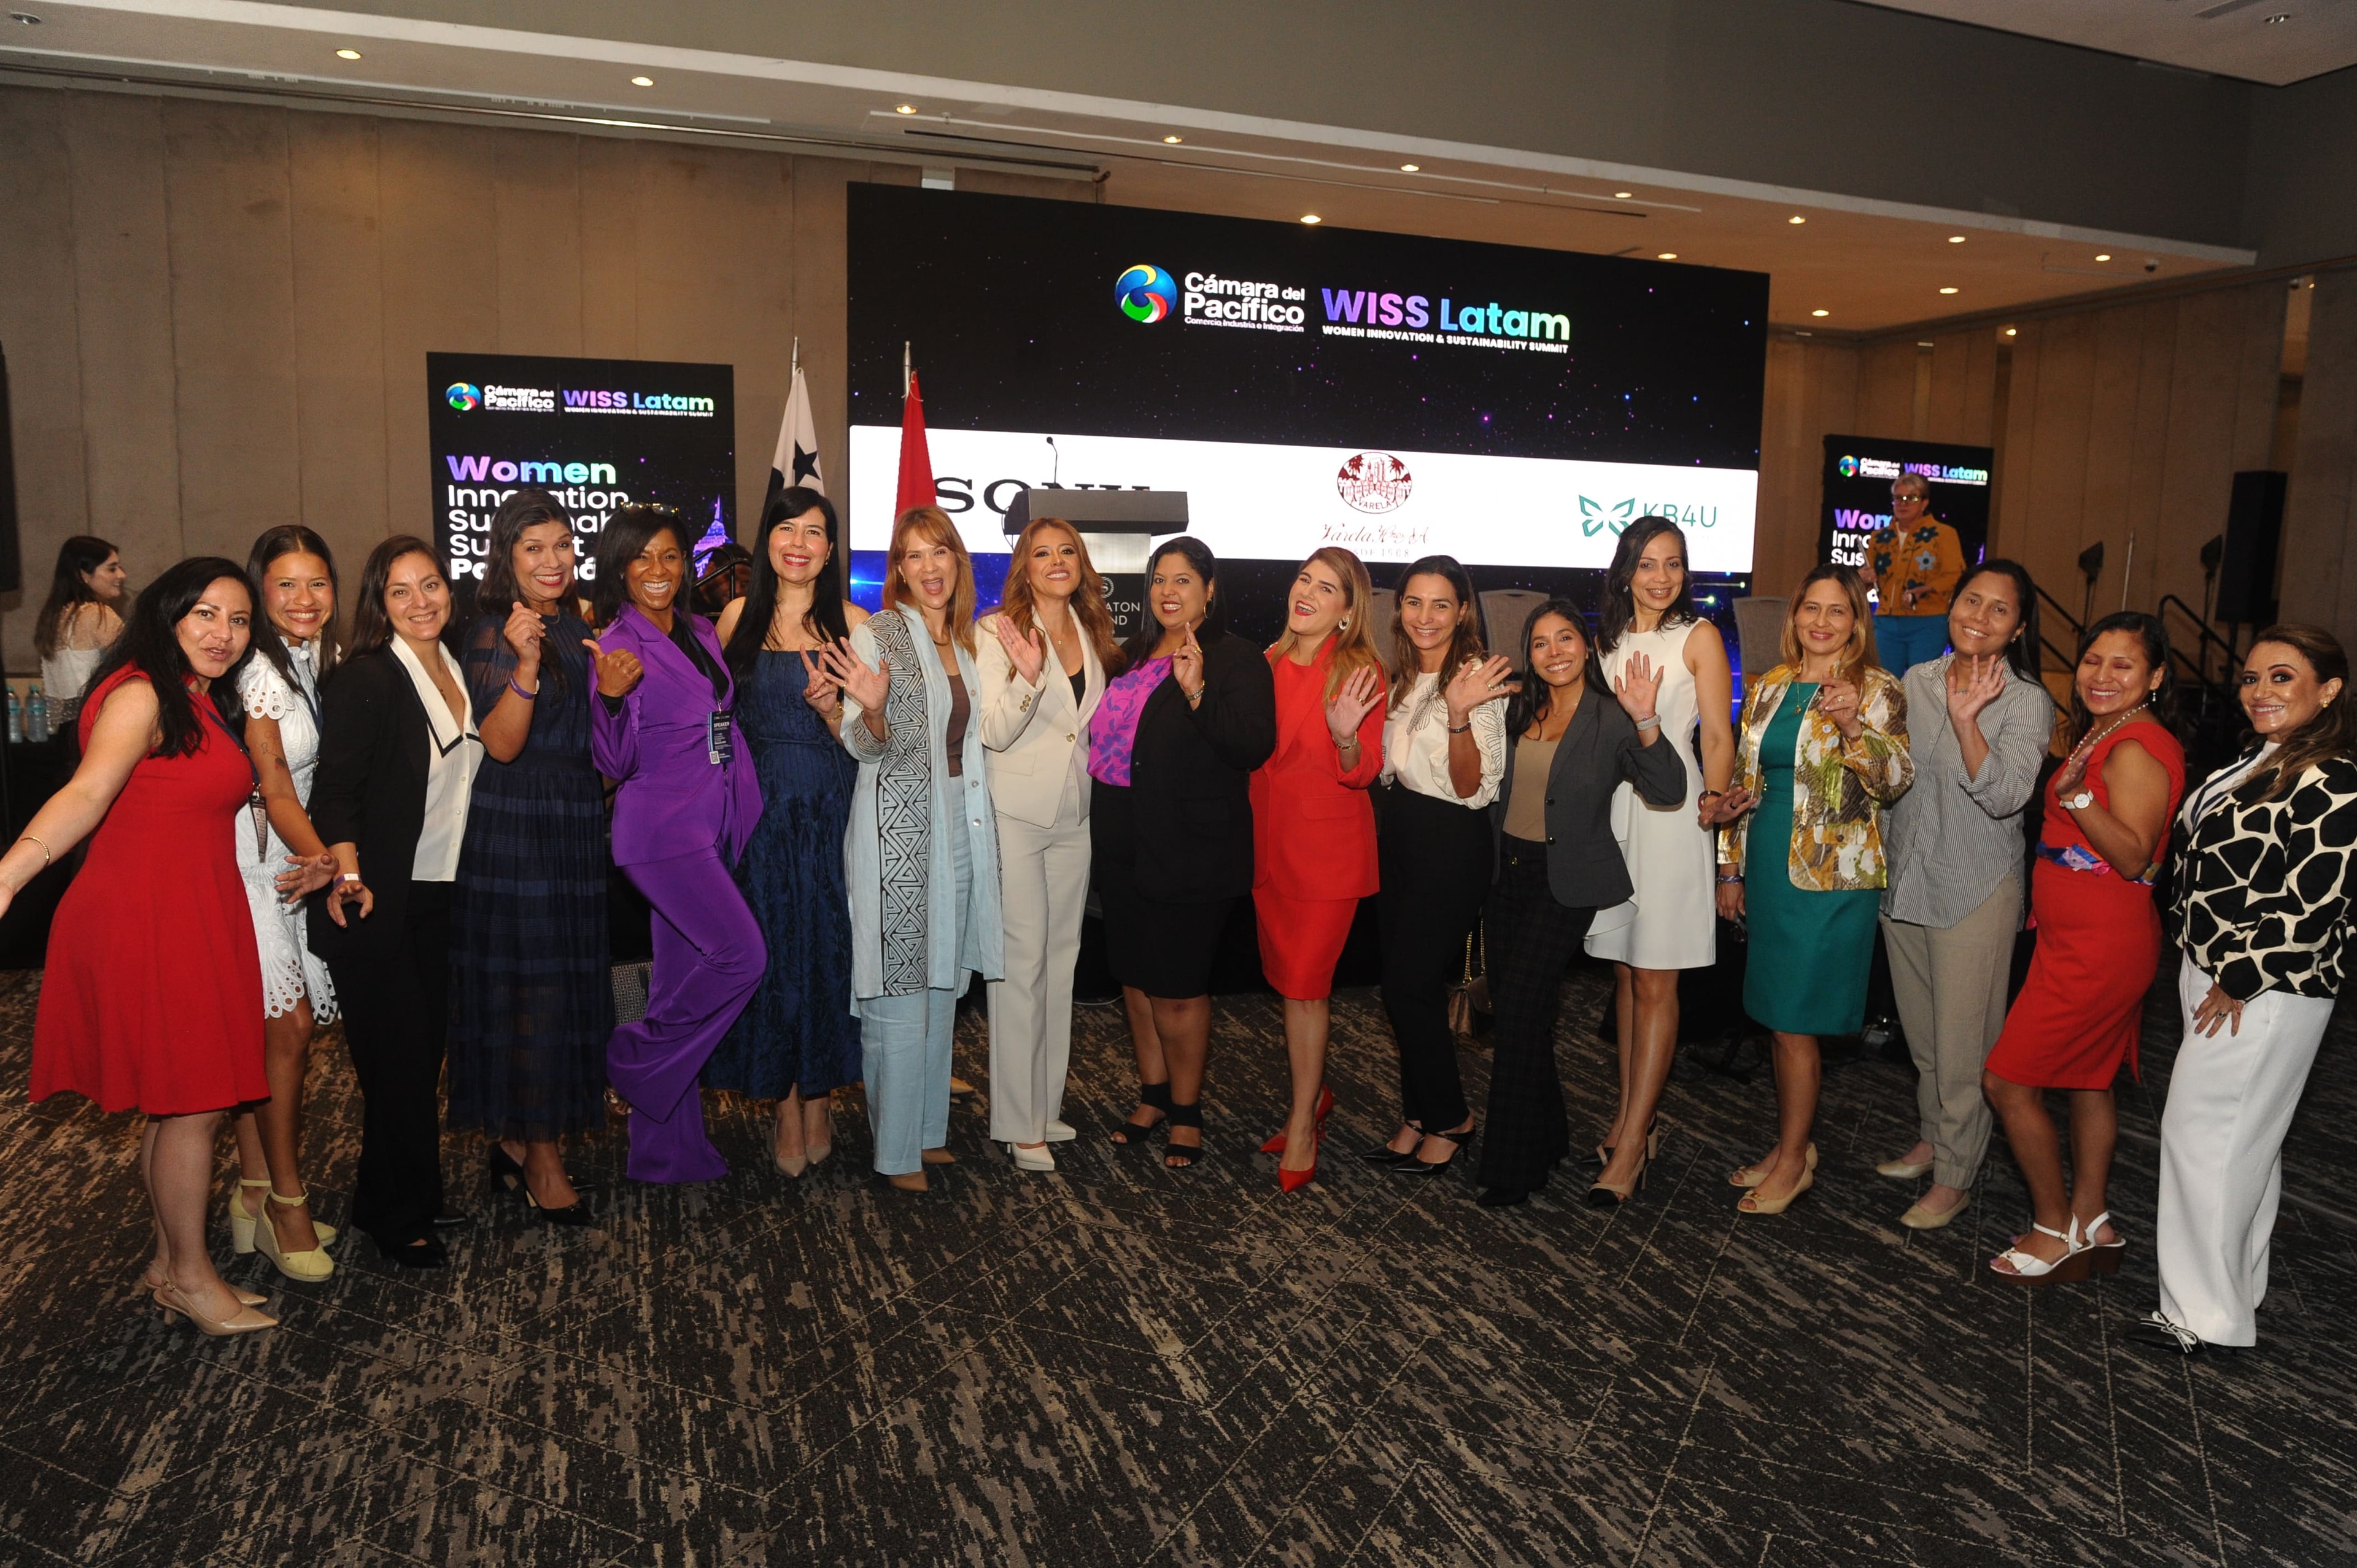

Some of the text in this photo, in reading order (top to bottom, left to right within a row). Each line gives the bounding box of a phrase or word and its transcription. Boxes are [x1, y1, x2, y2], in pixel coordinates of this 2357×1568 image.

[1185, 272, 1305, 301] Cámara del
[1184, 292, 1305, 324] Pacífico
[1322, 288, 1570, 341] WISS Latam
[1223, 320, 1256, 329] Industria
[1263, 322, 1304, 333] Integración
[1322, 325, 1569, 353] WOMEN INNOVATION & SUSTAINABILITY SUMMIT
[484, 385, 539, 397] Cámara
[484, 394, 555, 409] Pacífico
[563, 390, 714, 411] WISS Latam
[446, 455, 616, 484] Women
[1904, 462, 1940, 477] WISS
[1942, 465, 1988, 482] Latam
[448, 484, 629, 509] Inntion
[1359, 496, 1391, 509] VARELA
[1644, 503, 1717, 528] KB4U
[1382, 548, 1409, 558] 1908
